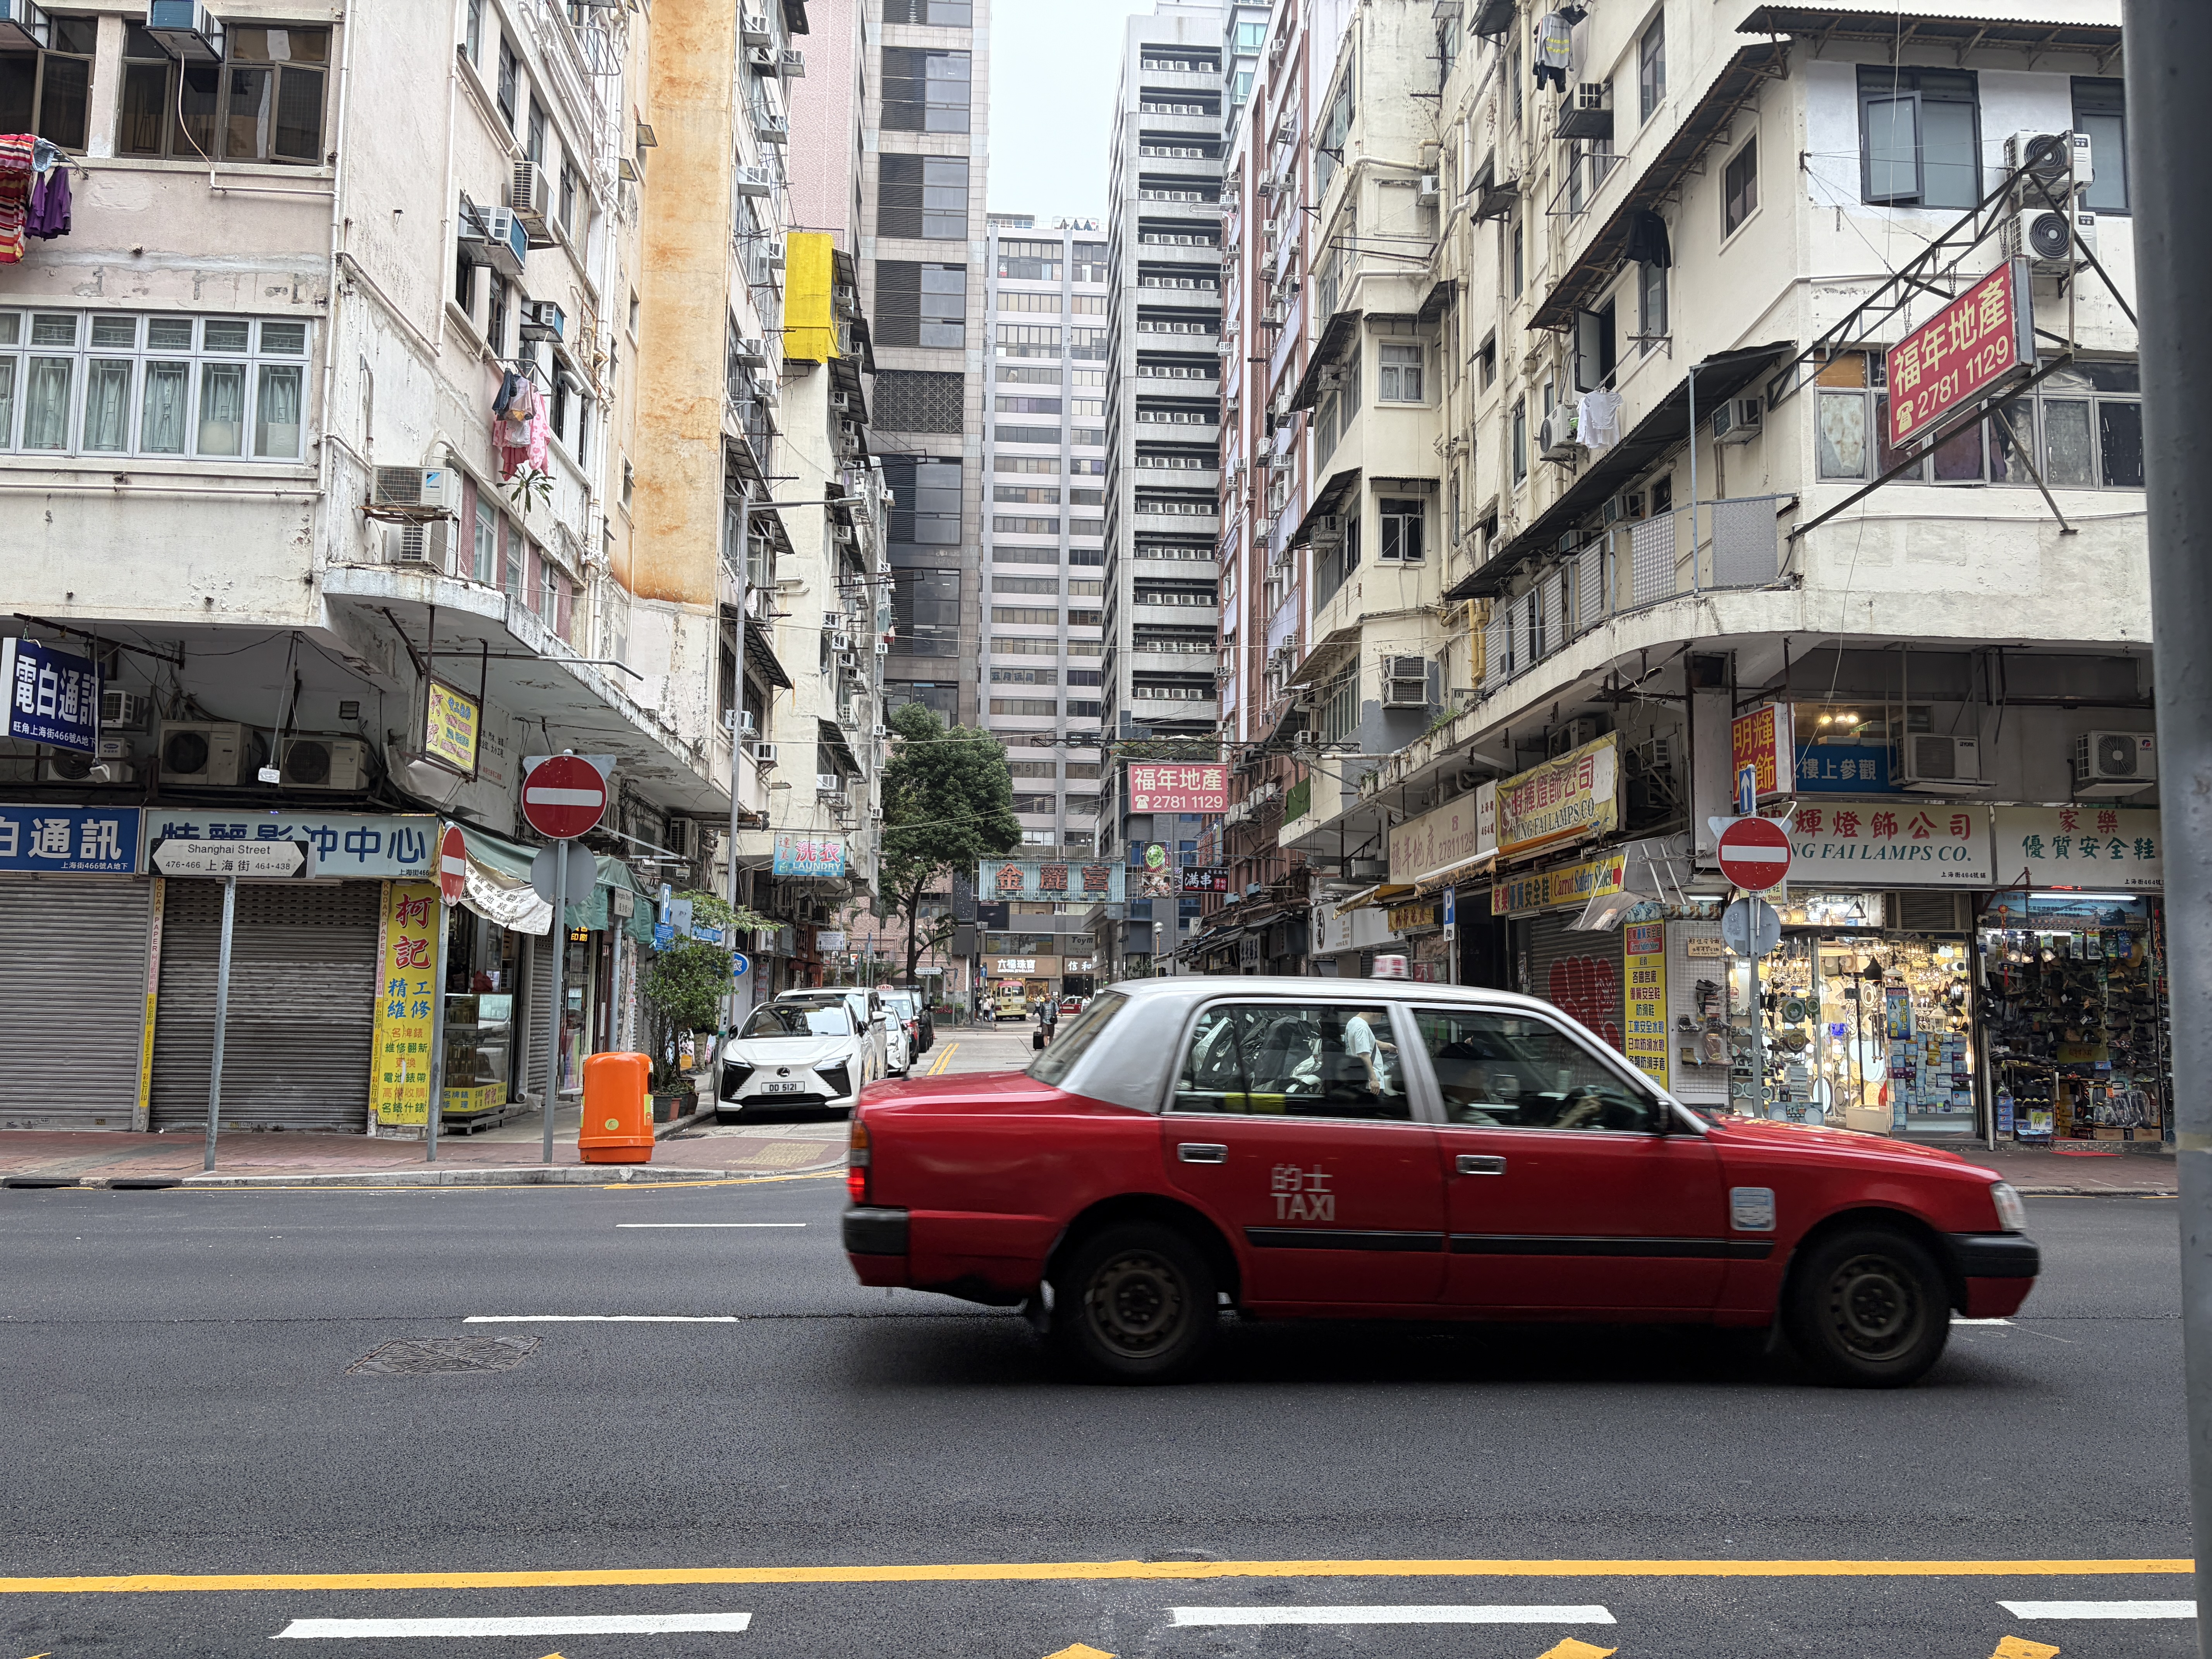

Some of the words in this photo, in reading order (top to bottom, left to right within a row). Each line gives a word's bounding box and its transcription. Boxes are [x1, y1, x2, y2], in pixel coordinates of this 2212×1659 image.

[1894, 276, 2007, 397] 福年地產
[1918, 369, 1958, 419] 2781
[1966, 336, 2009, 385] 1129
[16, 654, 100, 726] 電白通訊
[1733, 709, 1774, 757] 明輝
[1134, 768, 1223, 791] 福年地產
[1153, 795, 1186, 808] 2781
[1192, 795, 1223, 808] 1129
[1534, 814, 1547, 835] FAI
[1548, 802, 1579, 831] LAMPS
[1759, 809, 1971, 841] 輝燈飾公司
[2059, 809, 2119, 834] 家樂
[188, 844, 234, 855] Shanghai
[238, 845, 270, 854] Street
[795, 841, 840, 862] 洗衣
[1791, 843, 1816, 858] NG
[1820, 844, 1857, 859] FAI
[1860, 845, 1933, 860] LAMPS
[1938, 846, 1972, 862] CO.
[2022, 835, 2156, 861] 優質安全鞋
[61, 862, 128, 870] 上海街466號A地下
[205, 859, 250, 872] 上海街
[793, 862, 841, 871] LAUNDRY
[995, 862, 1110, 890] 金麗宮
[1554, 873, 1574, 896] Carrot
[1574, 868, 1594, 896] Safety
[1594, 865, 1613, 890] Shoes
[1445, 891, 1453, 913] P
[392, 893, 434, 969] 柯記
[998, 959, 1036, 969] 六福珠寶
[388, 978, 431, 998] 精工
[387, 1000, 431, 1019] 維修
[392, 1028, 423, 1038] 名牌錶
[385, 1043, 428, 1053] 維修翻新
[384, 1073, 426, 1083] 電池錶帶
[782, 1083, 797, 1091] 5121
[1271, 1163, 1333, 1192] 的士
[1269, 1193, 1335, 1221] TAXI
